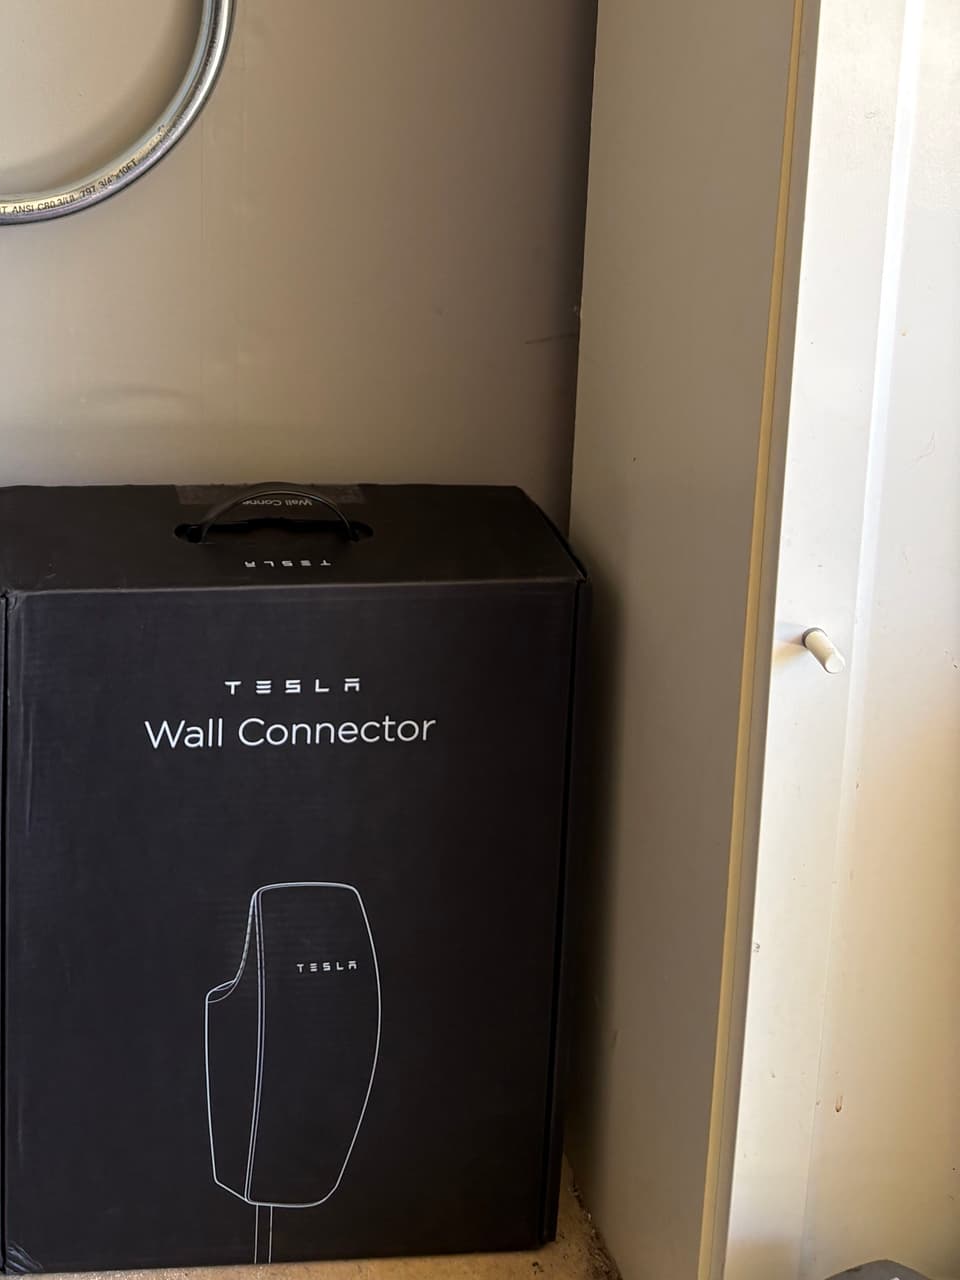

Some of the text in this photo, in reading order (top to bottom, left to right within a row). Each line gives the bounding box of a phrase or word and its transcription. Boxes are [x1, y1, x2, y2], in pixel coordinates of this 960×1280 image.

[285, 498, 313, 506] Wall
[244, 559, 331, 568] TESLA
[224, 677, 361, 695] TESLA
[144, 716, 436, 749] Wall Connector
[296, 960, 357, 973] TESLA
